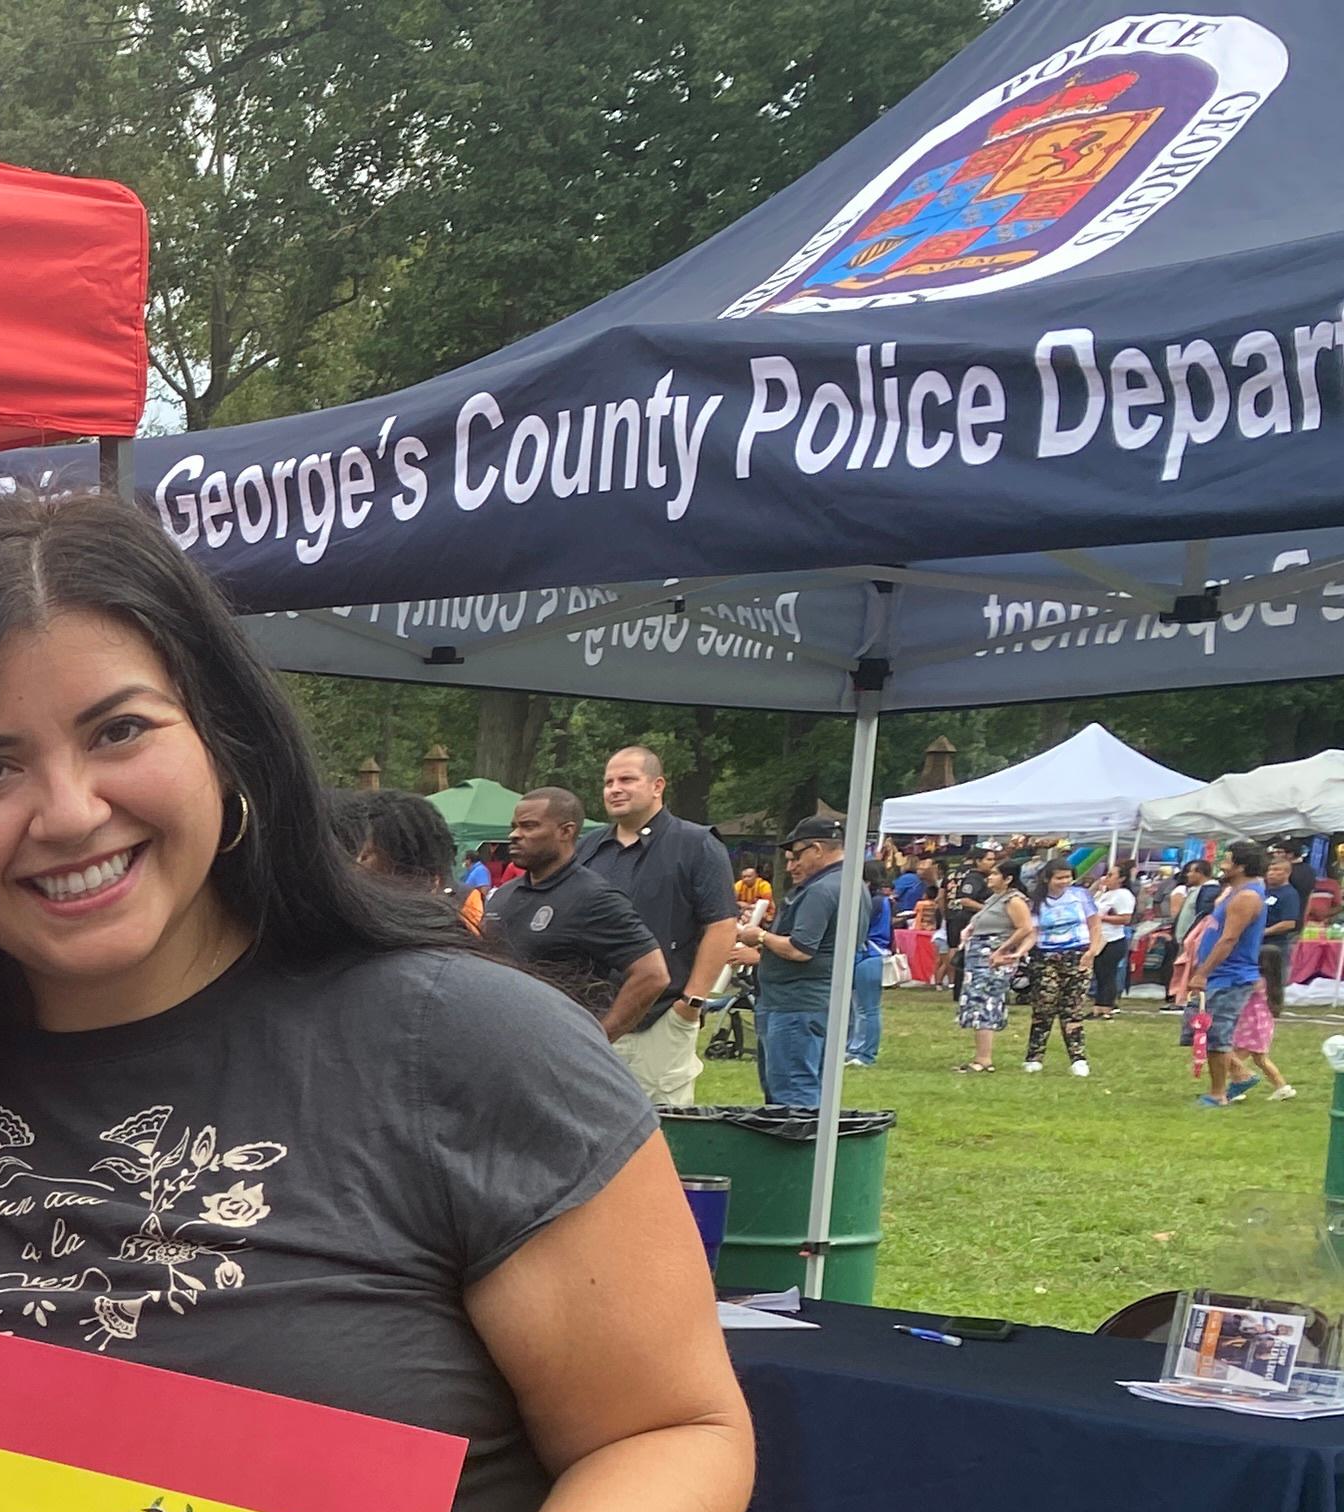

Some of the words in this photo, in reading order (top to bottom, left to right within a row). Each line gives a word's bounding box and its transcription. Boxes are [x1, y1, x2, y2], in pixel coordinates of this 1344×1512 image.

[1001, 19, 1219, 104] POLICE
[156, 416, 431, 564] George's
[454, 368, 723, 521] County
[736, 341, 1007, 480] Police
[52, 1218, 86, 1257] la
